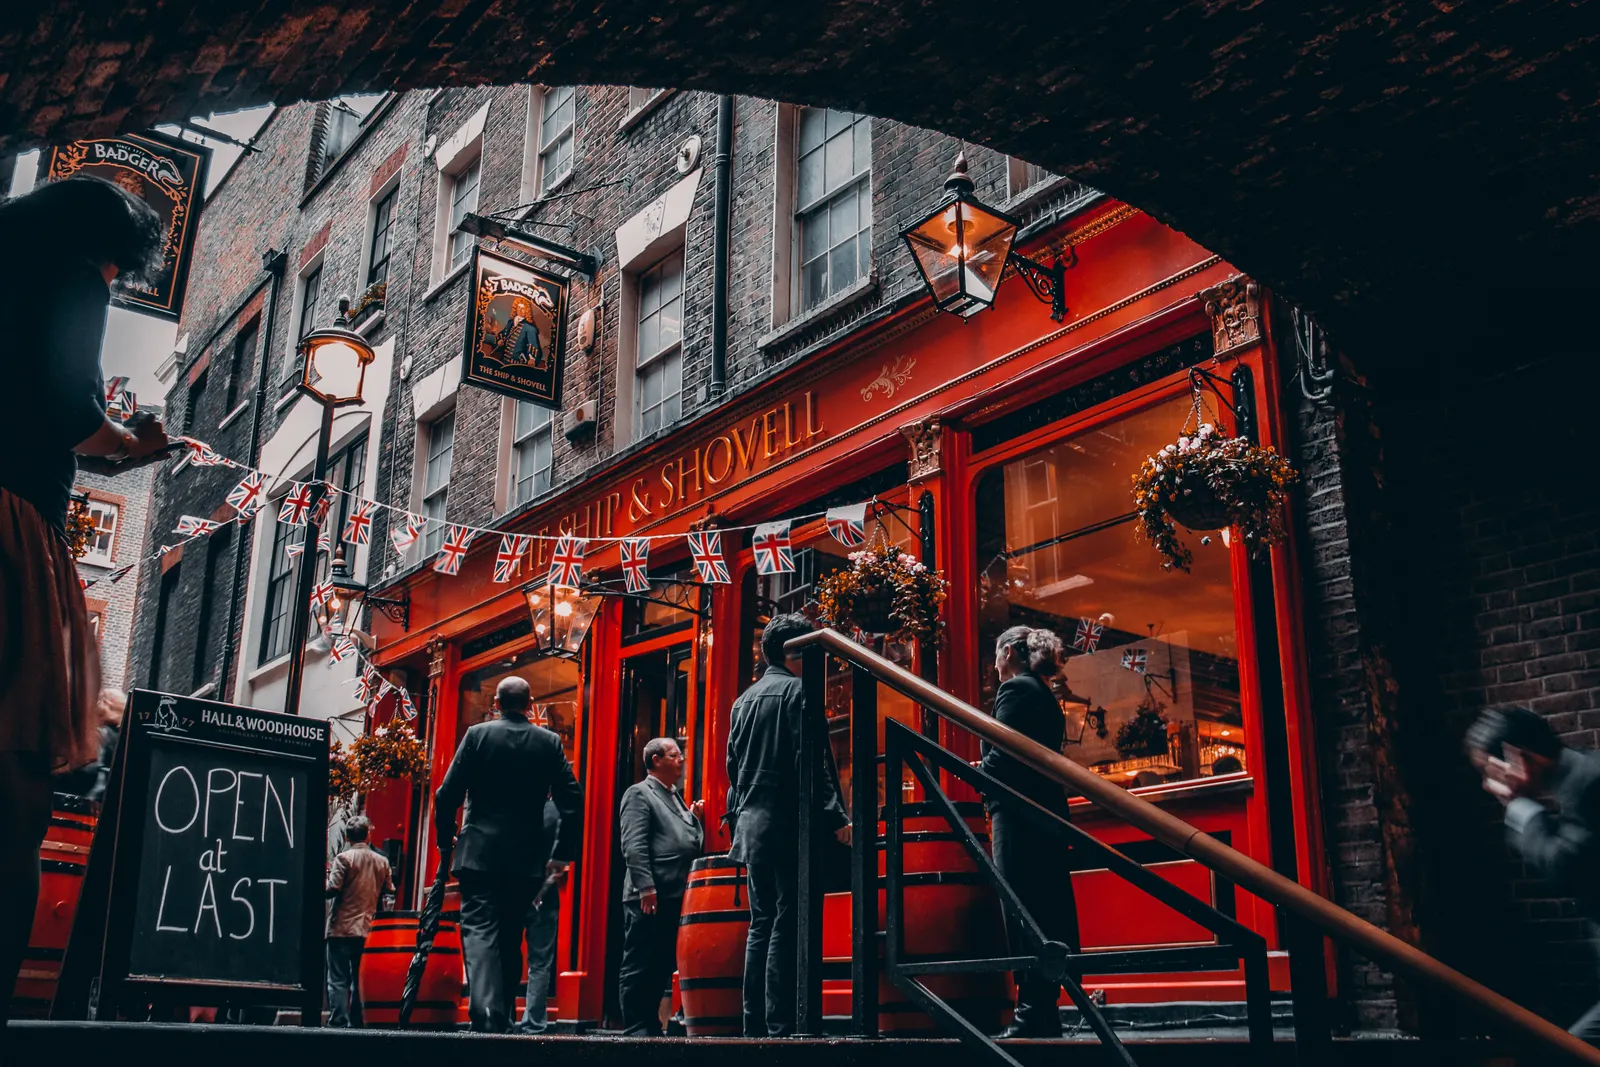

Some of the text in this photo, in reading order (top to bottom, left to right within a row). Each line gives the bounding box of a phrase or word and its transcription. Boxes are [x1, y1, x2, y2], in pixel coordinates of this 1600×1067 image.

[94, 143, 160, 181] BADGER
[501, 279, 541, 306] BADGER
[479, 365, 493, 375] THE
[494, 369, 510, 380] SHIP
[517, 377, 547, 391] SHOVELL
[628, 479, 652, 524] &
[659, 390, 825, 508] SHOVELL
[155, 766, 294, 849] OPEN
[199, 839, 228, 873] at
[156, 865, 288, 943] LAST
